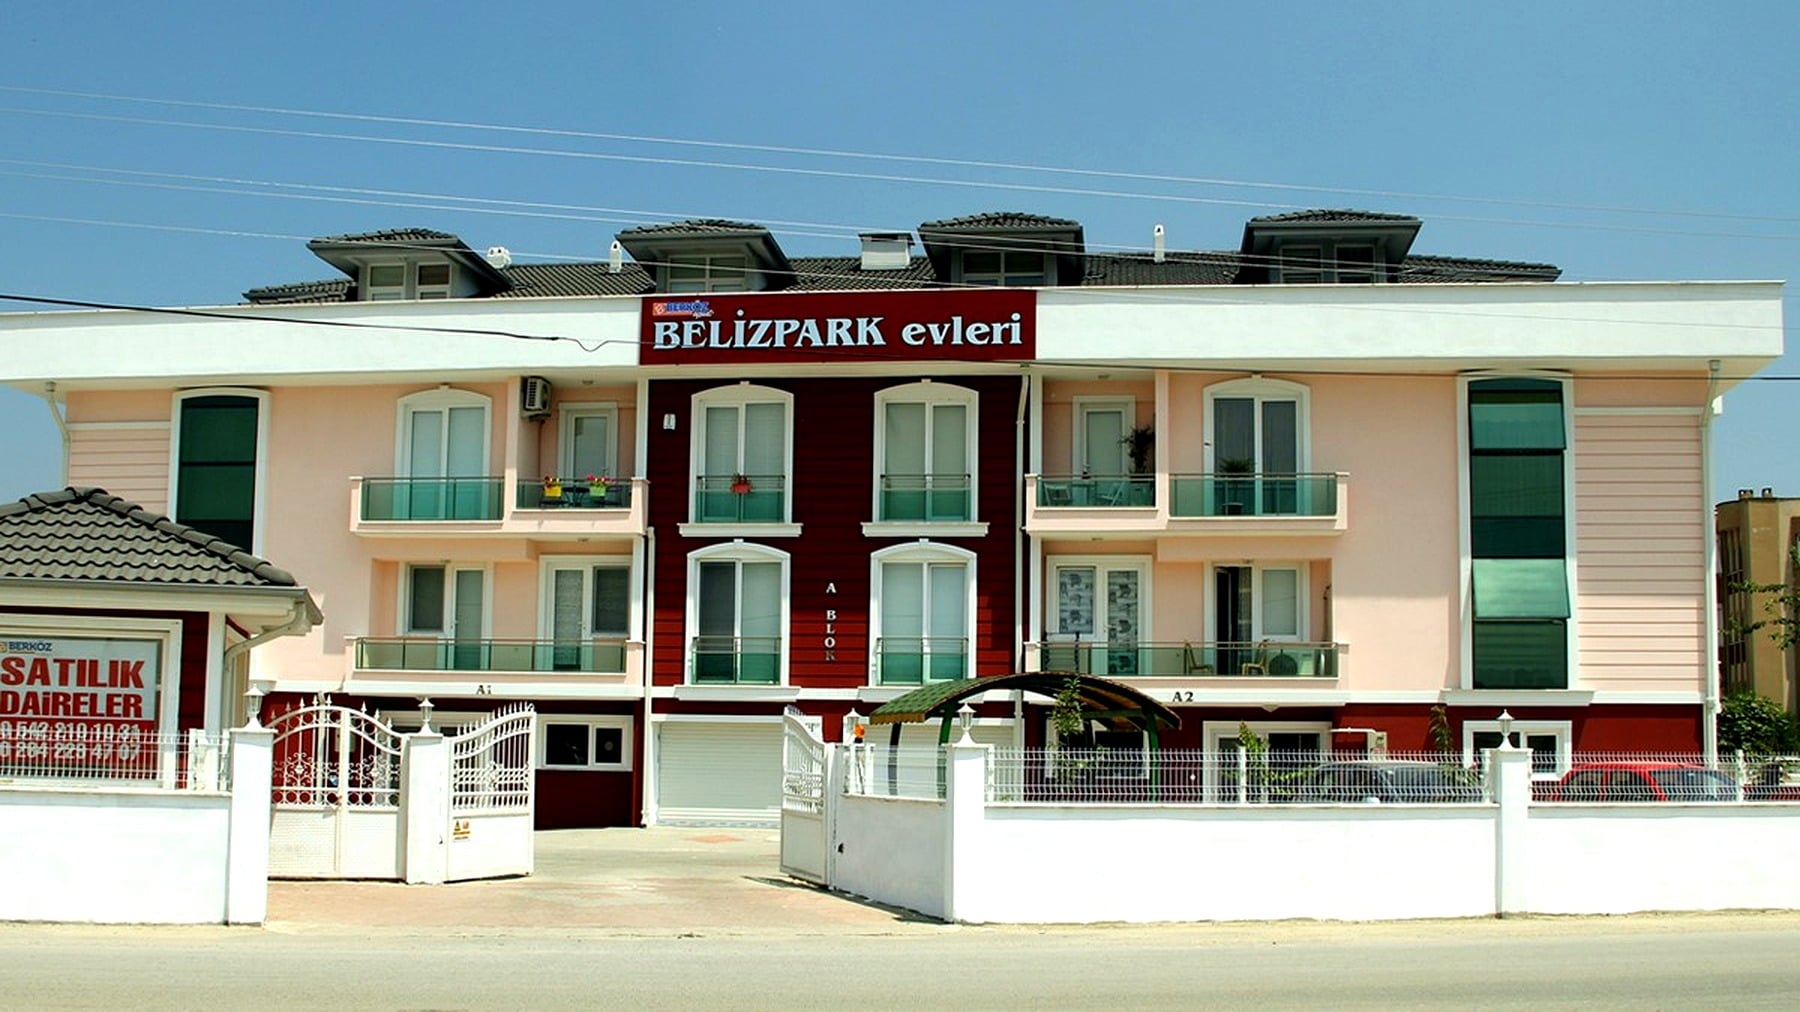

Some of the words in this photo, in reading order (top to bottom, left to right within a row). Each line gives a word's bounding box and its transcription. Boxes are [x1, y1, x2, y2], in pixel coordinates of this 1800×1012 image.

[901, 312, 1023, 346] evleri
[825, 582, 837, 594] A
[824, 609, 837, 661] BLOK
[1, 656, 145, 689] SATILIK
[1172, 691, 1194, 703] A2
